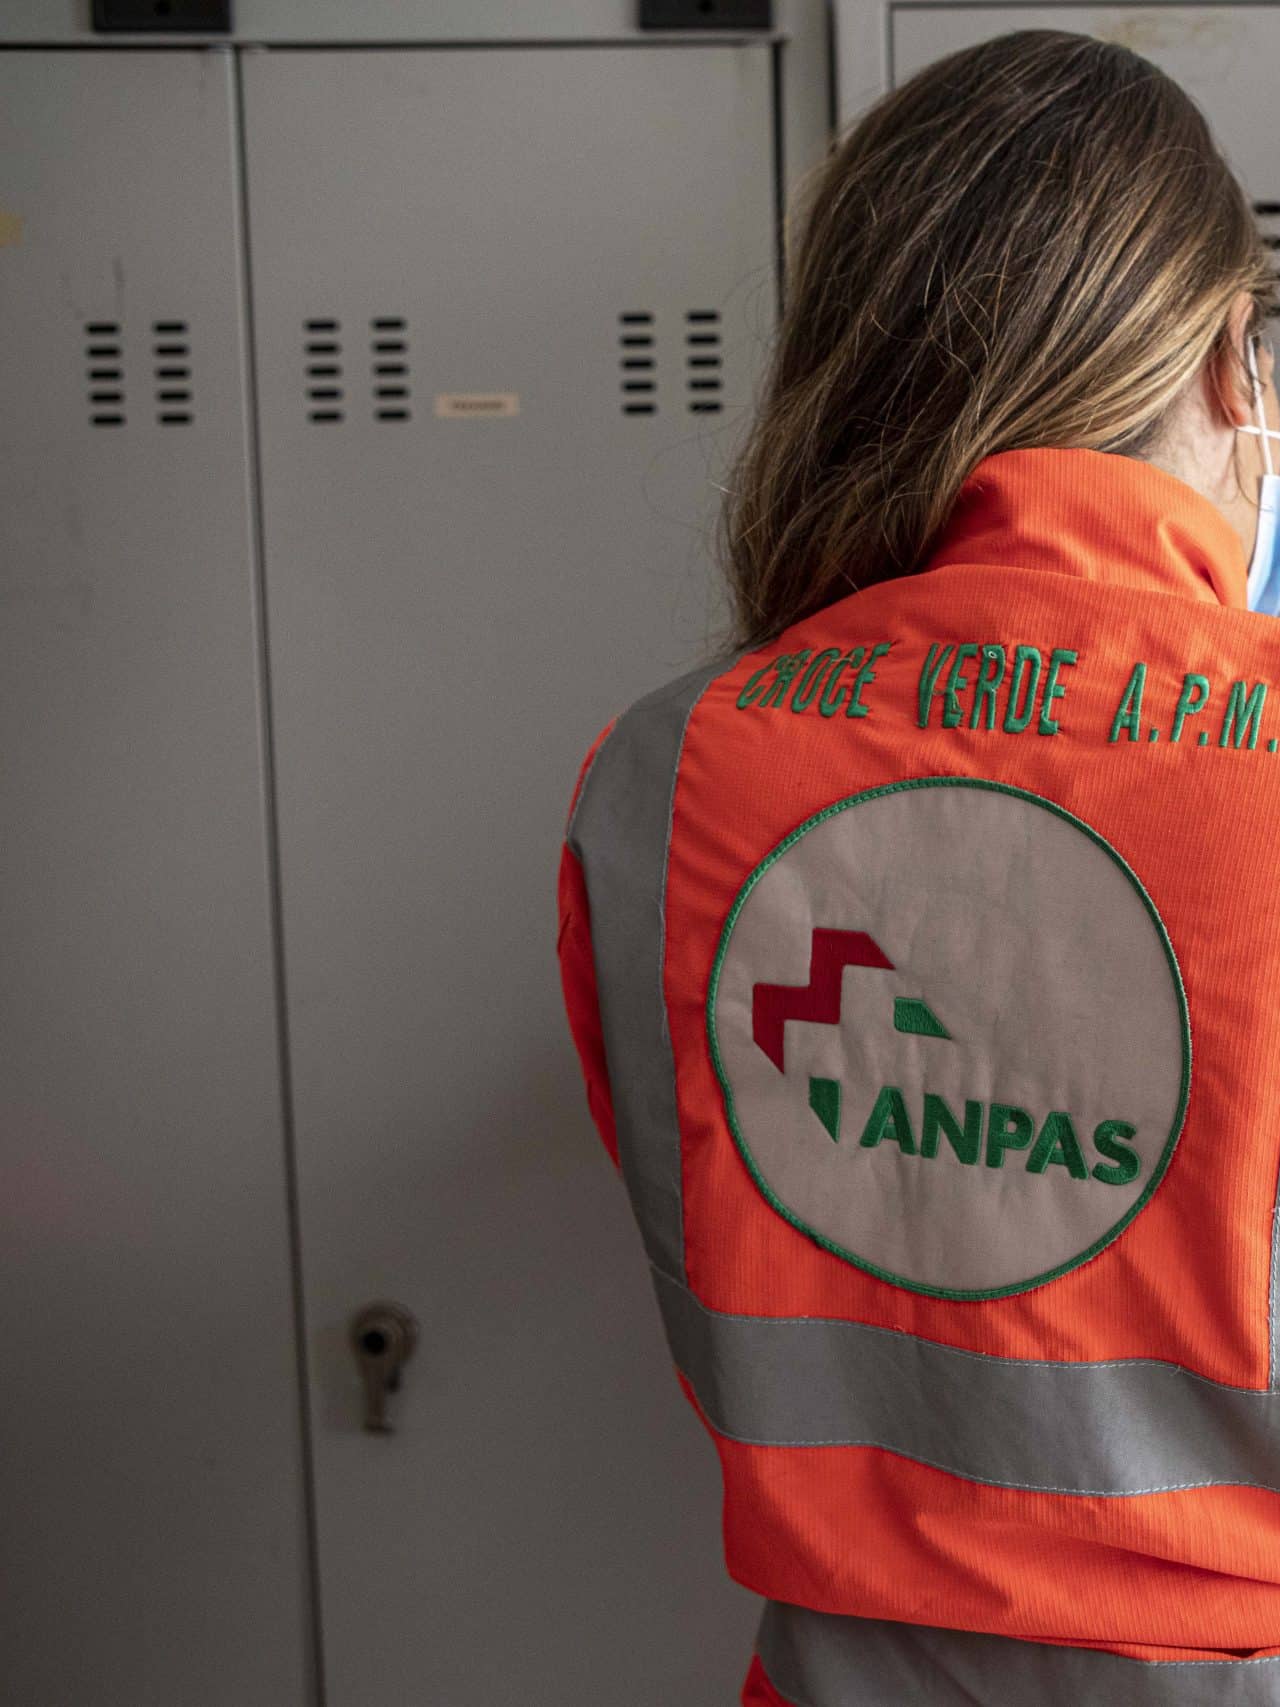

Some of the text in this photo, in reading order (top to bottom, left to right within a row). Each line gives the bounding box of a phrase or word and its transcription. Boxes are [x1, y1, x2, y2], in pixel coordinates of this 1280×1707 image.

[736, 643, 1279, 753] CROCE VERDE A.P.M.
[859, 1085, 1142, 1186] ANPAS
